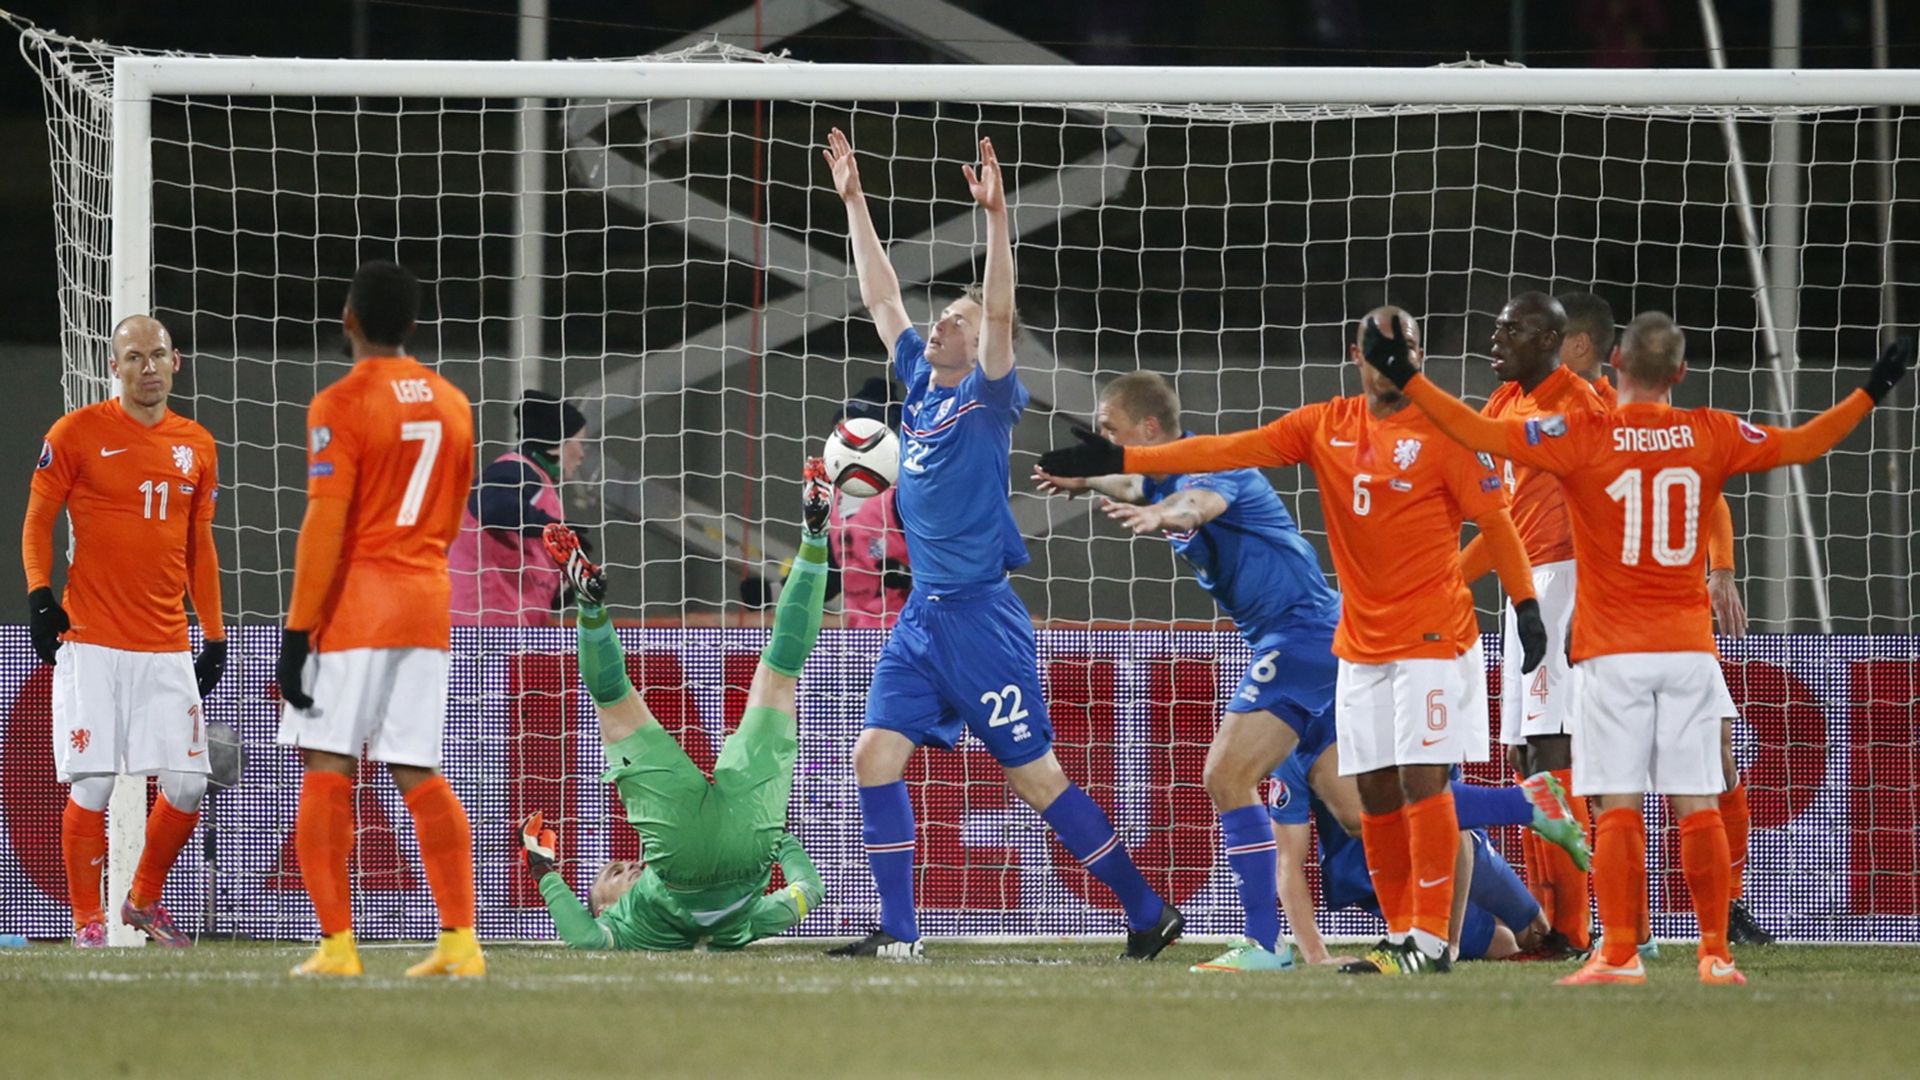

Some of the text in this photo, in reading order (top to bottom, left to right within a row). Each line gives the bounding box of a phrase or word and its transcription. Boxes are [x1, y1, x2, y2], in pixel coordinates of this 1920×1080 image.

[391, 378, 433, 403] LENS
[396, 420, 442, 526] 7
[138, 480, 168, 520] 11
[1353, 473, 1371, 516] 6
[1605, 466, 1701, 567] 10
[1251, 650, 1280, 683] 6
[1530, 664, 1549, 704] 4
[980, 684, 1029, 728] 22
[1426, 689, 1447, 731] 6
